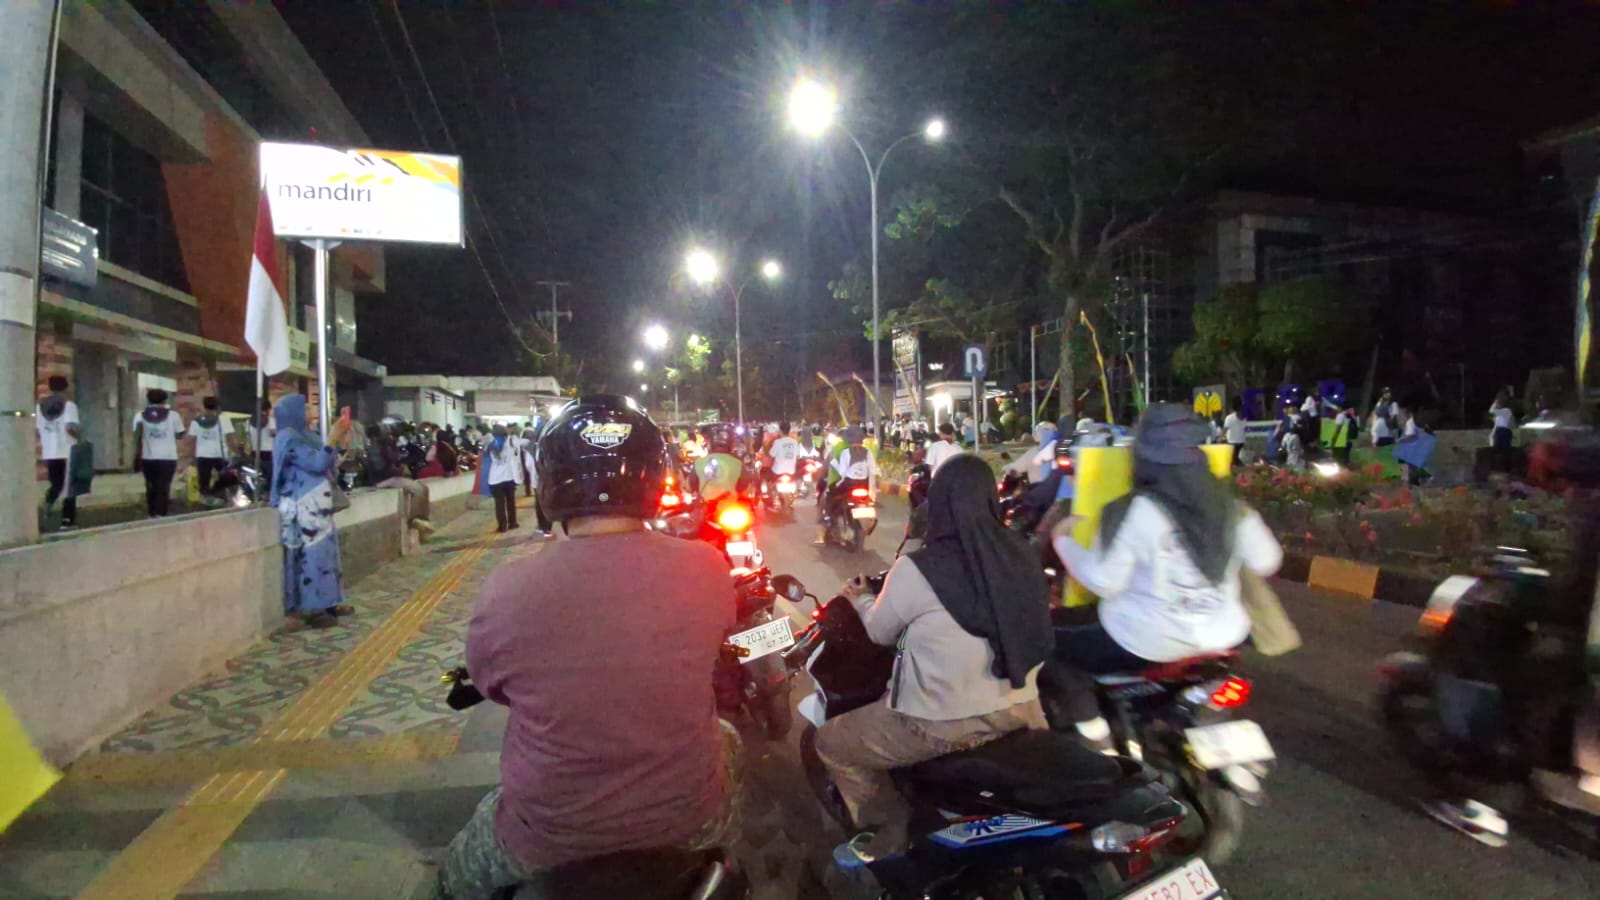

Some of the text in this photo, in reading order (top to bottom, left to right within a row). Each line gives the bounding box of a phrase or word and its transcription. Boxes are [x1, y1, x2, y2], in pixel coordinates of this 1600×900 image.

[279, 182, 371, 202] mandiri
[590, 435, 619, 444] YAMAHA
[1185, 866, 1214, 896] EX
